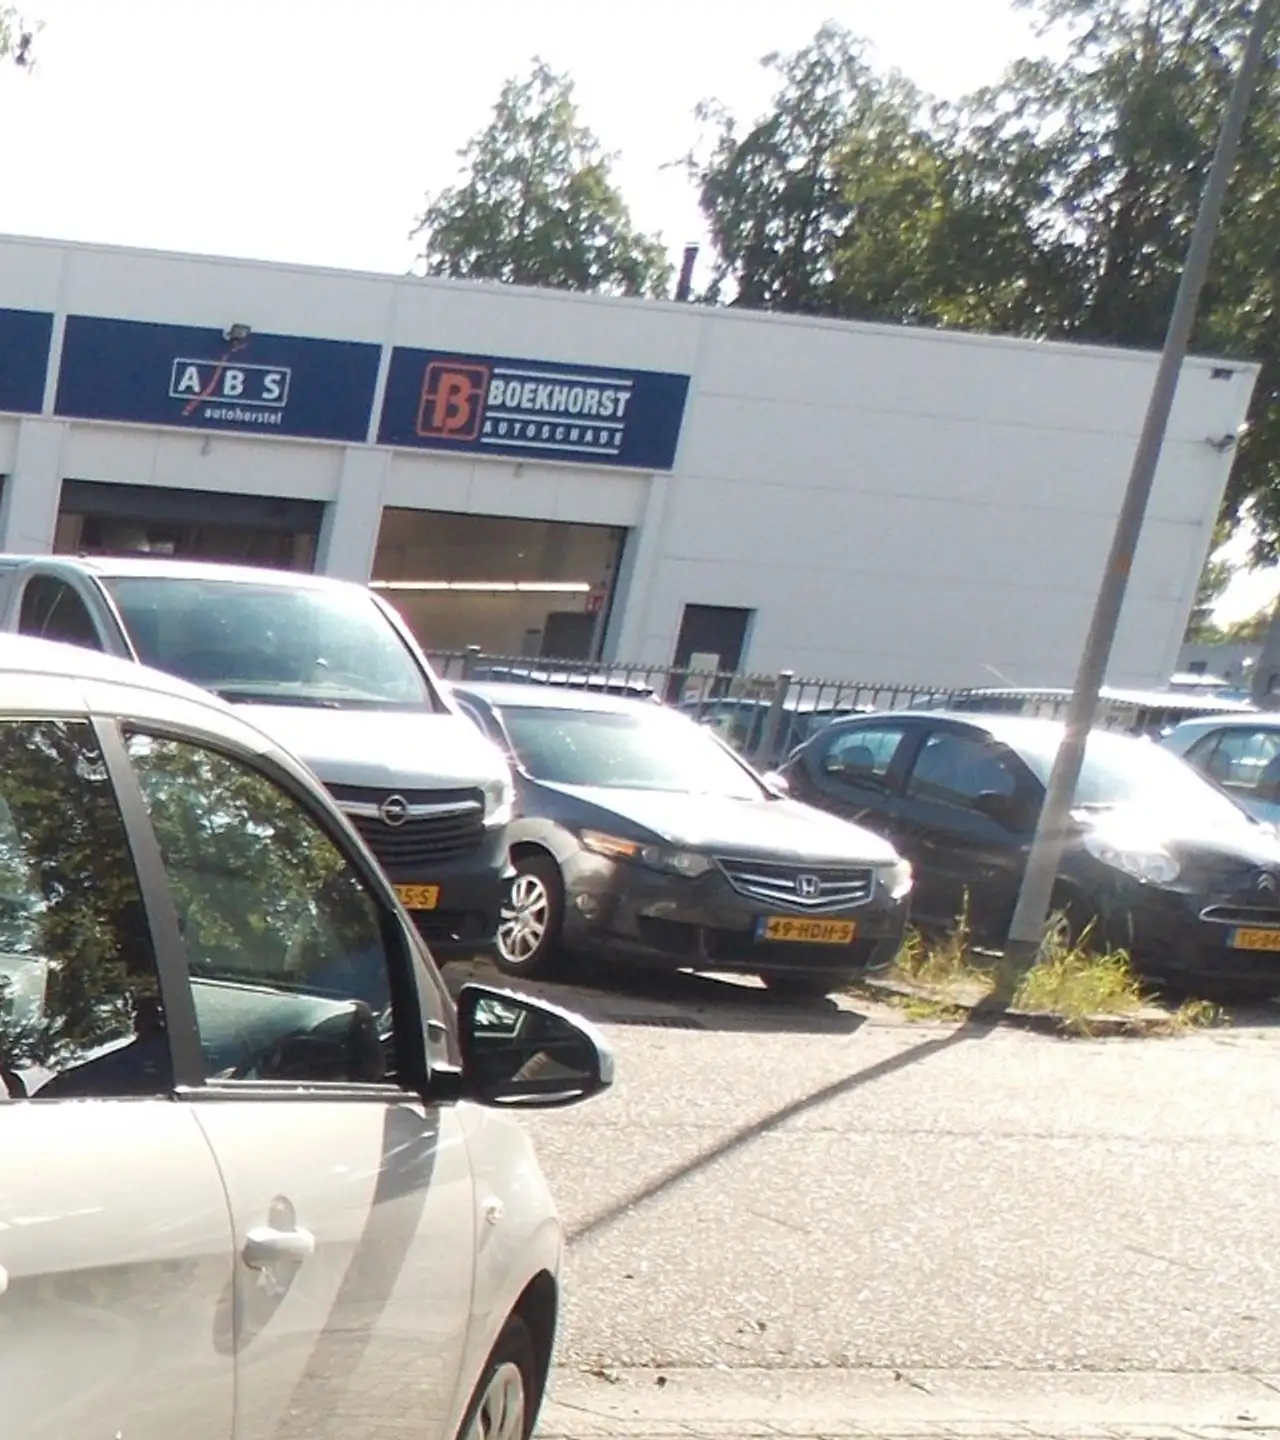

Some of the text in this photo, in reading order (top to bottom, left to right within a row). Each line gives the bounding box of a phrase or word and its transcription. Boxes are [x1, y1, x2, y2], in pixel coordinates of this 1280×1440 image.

[486, 379, 632, 417] BOEKHORST
[204, 406, 284, 425] autoherstel
[482, 418, 624, 448] AUTOSCHADE
